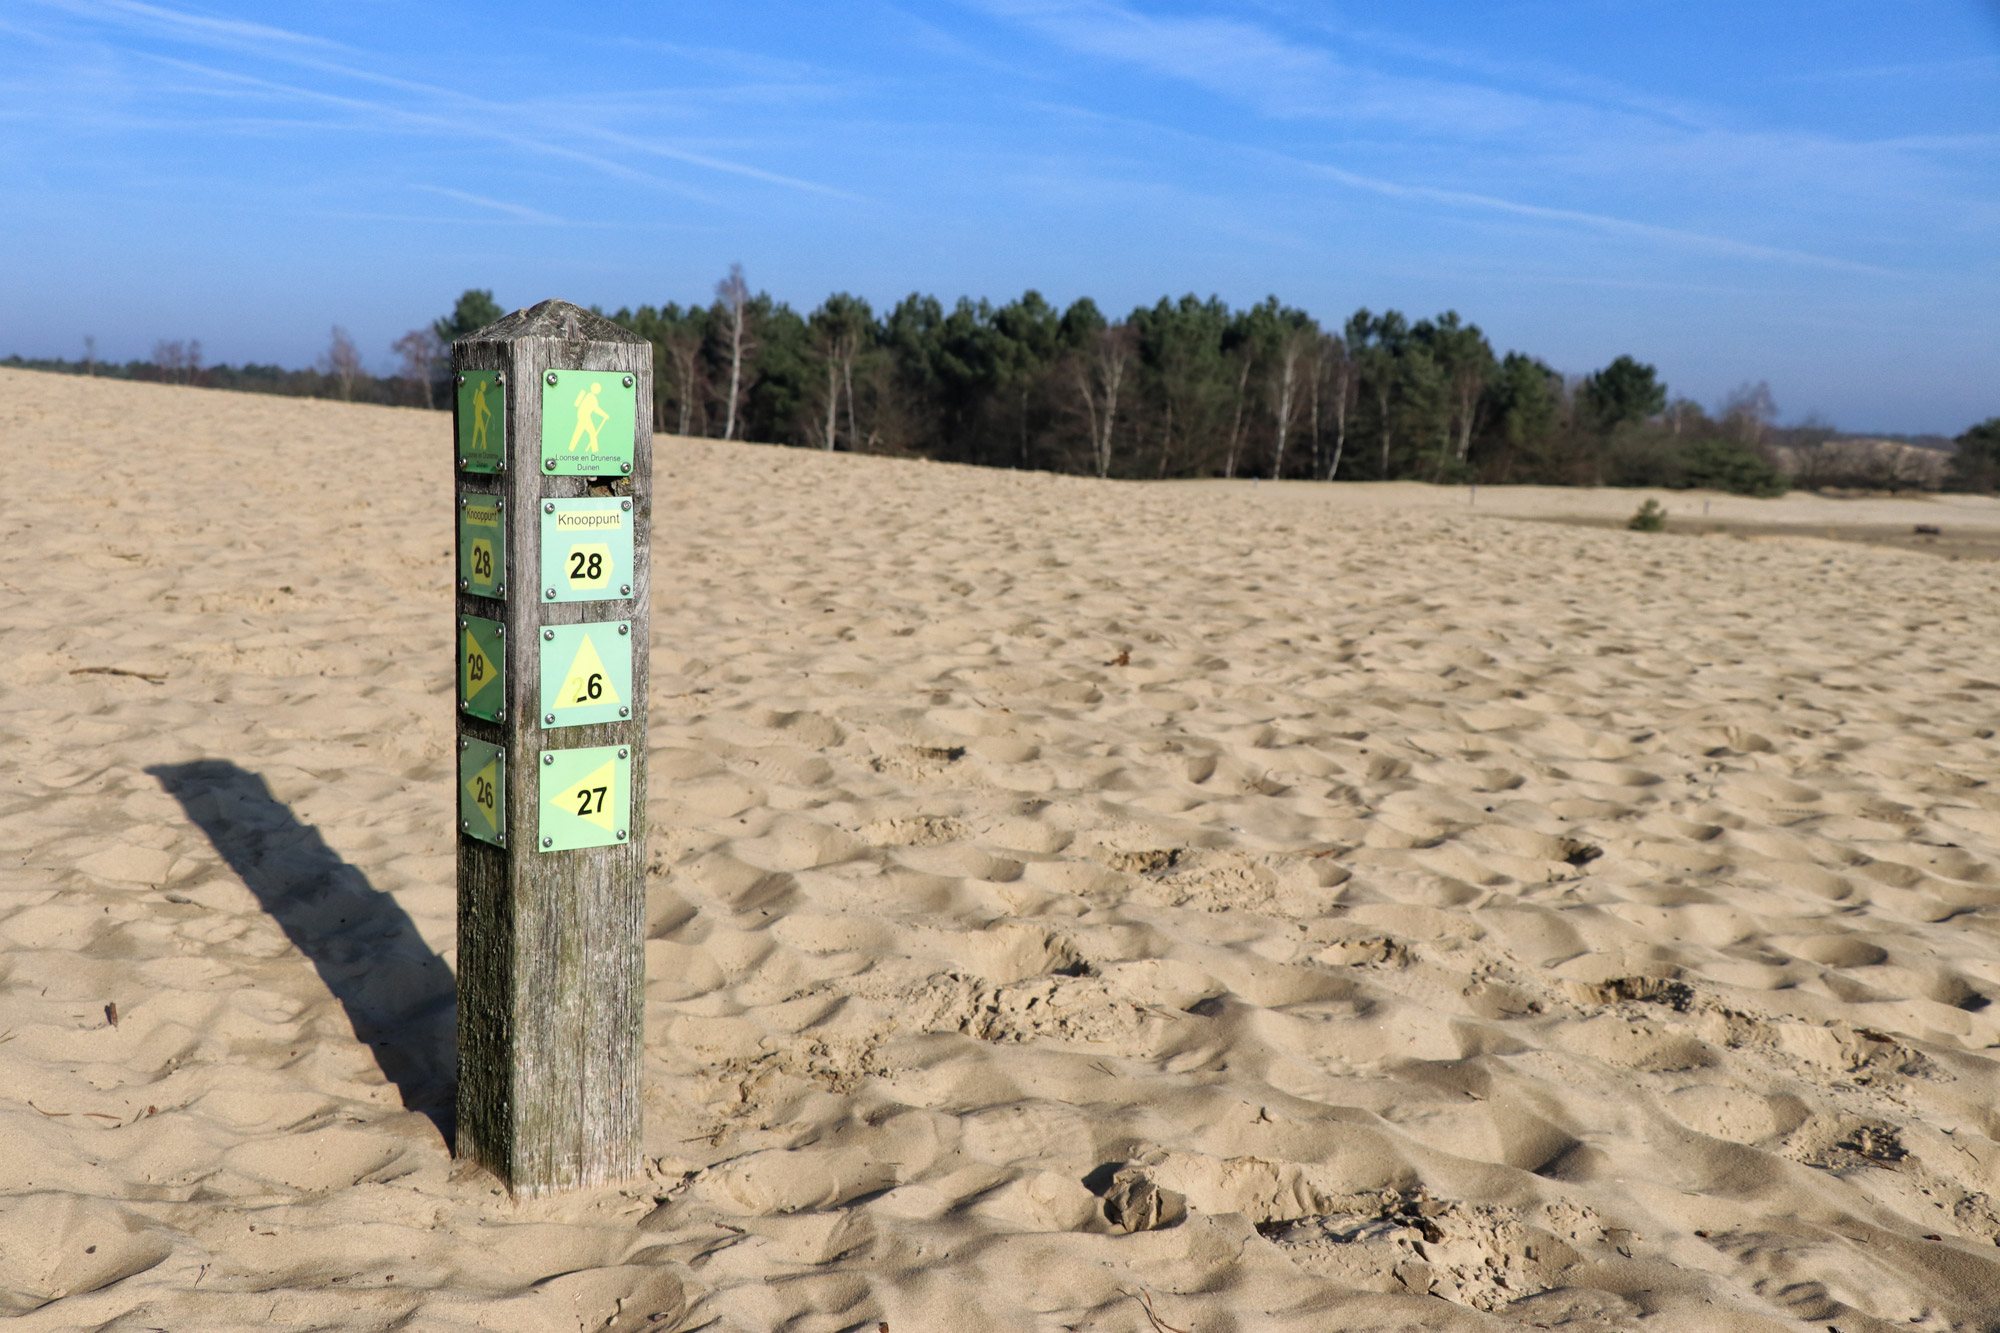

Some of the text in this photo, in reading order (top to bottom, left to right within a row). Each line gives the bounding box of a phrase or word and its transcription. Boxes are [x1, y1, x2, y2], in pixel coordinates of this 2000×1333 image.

[577, 463, 600, 471] Duinen
[590, 454, 621, 462] Drunense
[466, 508, 498, 523] Knooppunt
[558, 513, 620, 527] Knooppunt
[474, 547, 491, 578] 28
[570, 552, 602, 580] 28
[468, 653, 484, 681] 29
[476, 776, 493, 809] 26
[577, 786, 608, 816] 27
